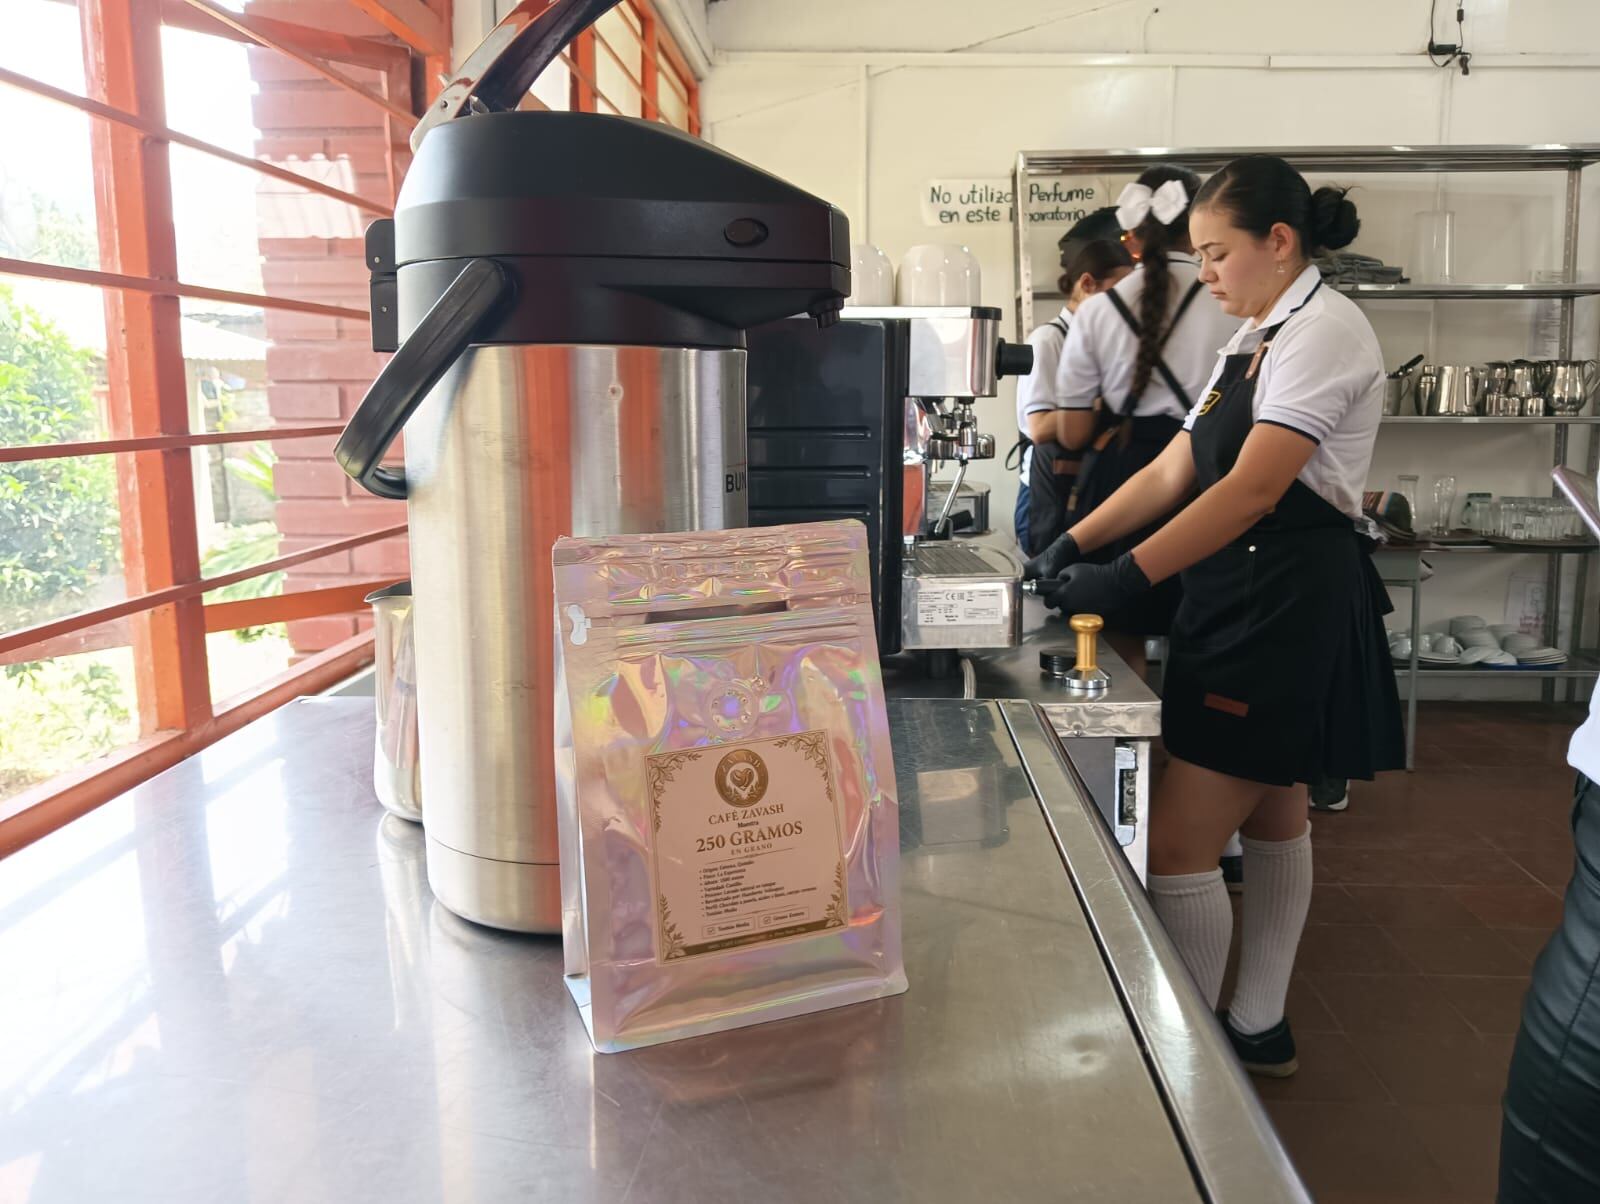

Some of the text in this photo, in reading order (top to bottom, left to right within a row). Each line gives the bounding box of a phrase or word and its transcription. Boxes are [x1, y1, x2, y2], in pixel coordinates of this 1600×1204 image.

[930, 185, 951, 204] No
[1029, 182, 1095, 205] Perfume
[939, 210, 960, 223] en
[966, 205, 1001, 223] este
[709, 804, 784, 824] CAFÉ ZAVASH
[696, 821, 803, 853] 250 GRAMOS
[731, 843, 773, 856] EN GRANO
